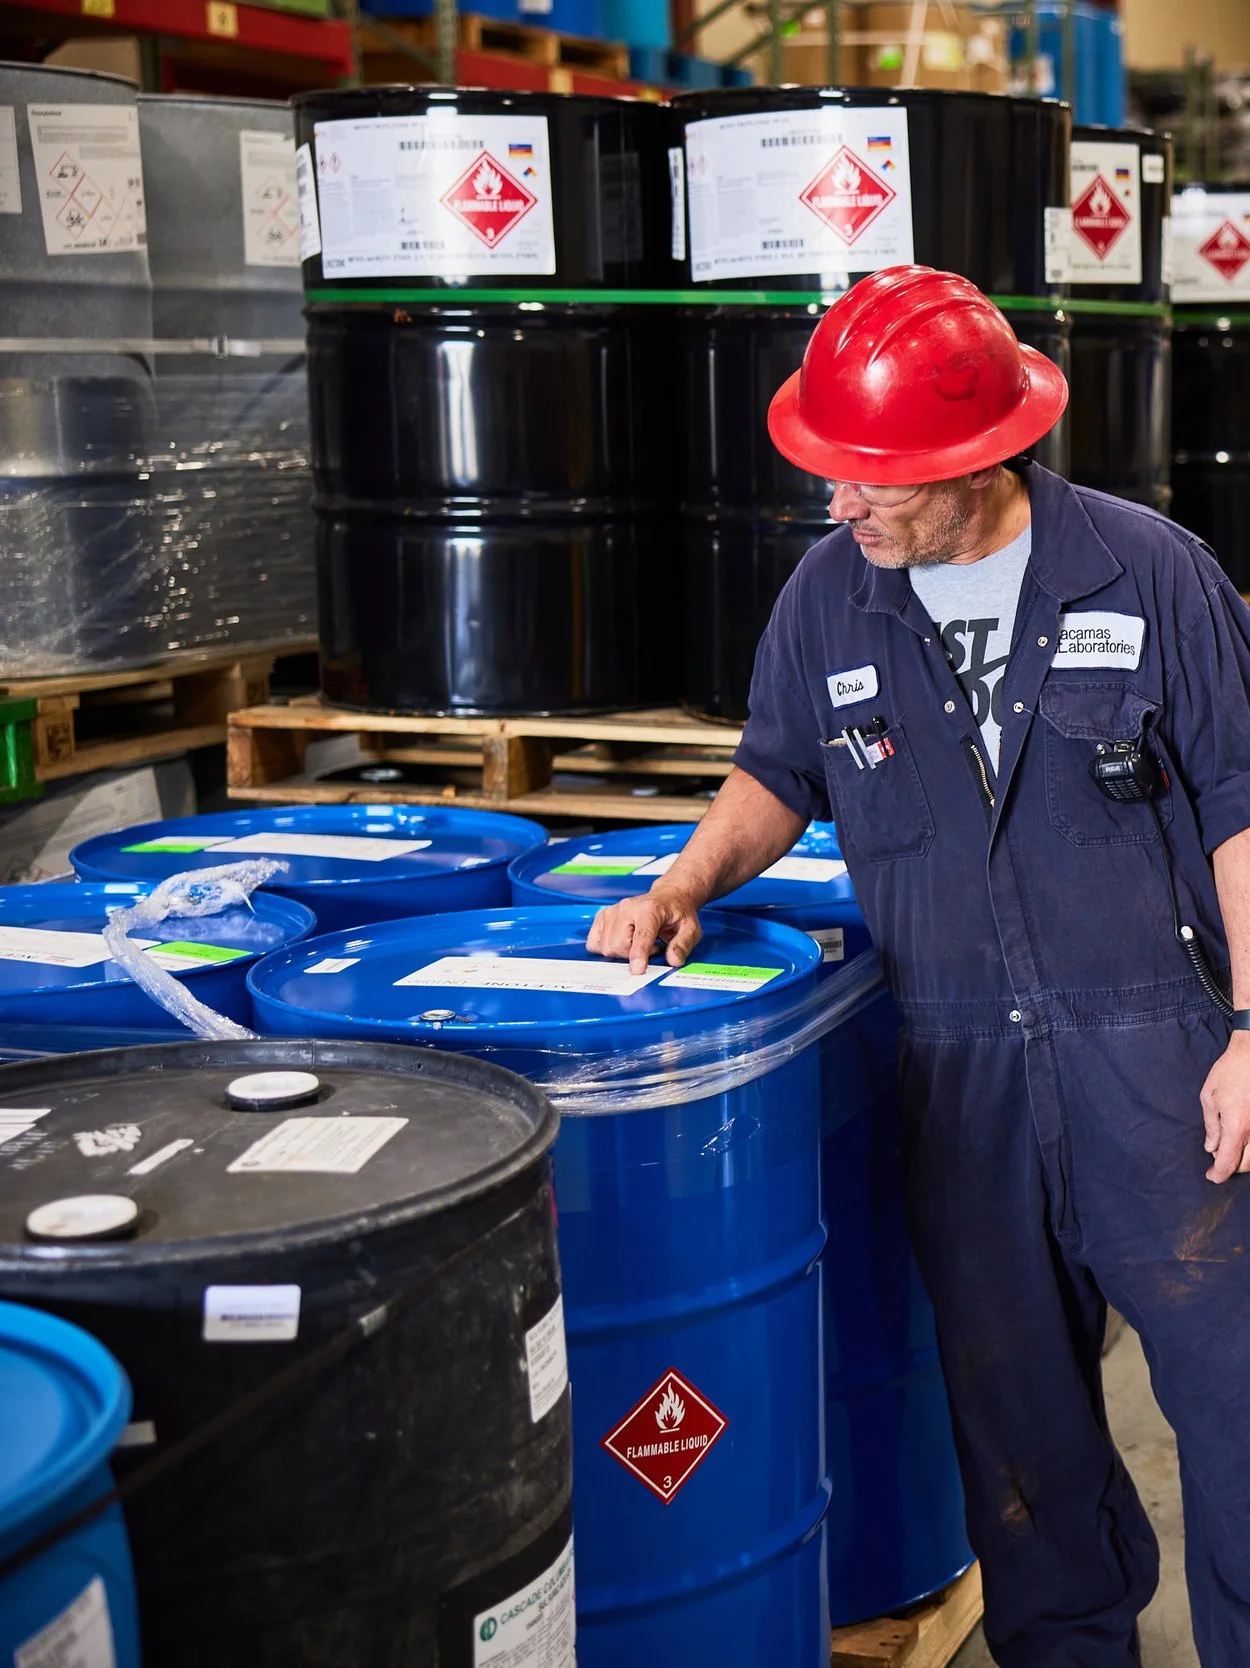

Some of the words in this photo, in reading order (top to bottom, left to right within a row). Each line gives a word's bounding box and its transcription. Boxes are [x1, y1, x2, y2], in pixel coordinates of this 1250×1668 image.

[932, 617, 999, 674] ST
[1057, 639, 1136, 656] Laboratories
[836, 679, 864, 696] Chris
[481, 981, 574, 990] ACETONE
[626, 1440, 679, 1459] FLAMMABLE
[681, 1434, 708, 1451] LIQUID
[663, 1475, 673, 1488] 3
